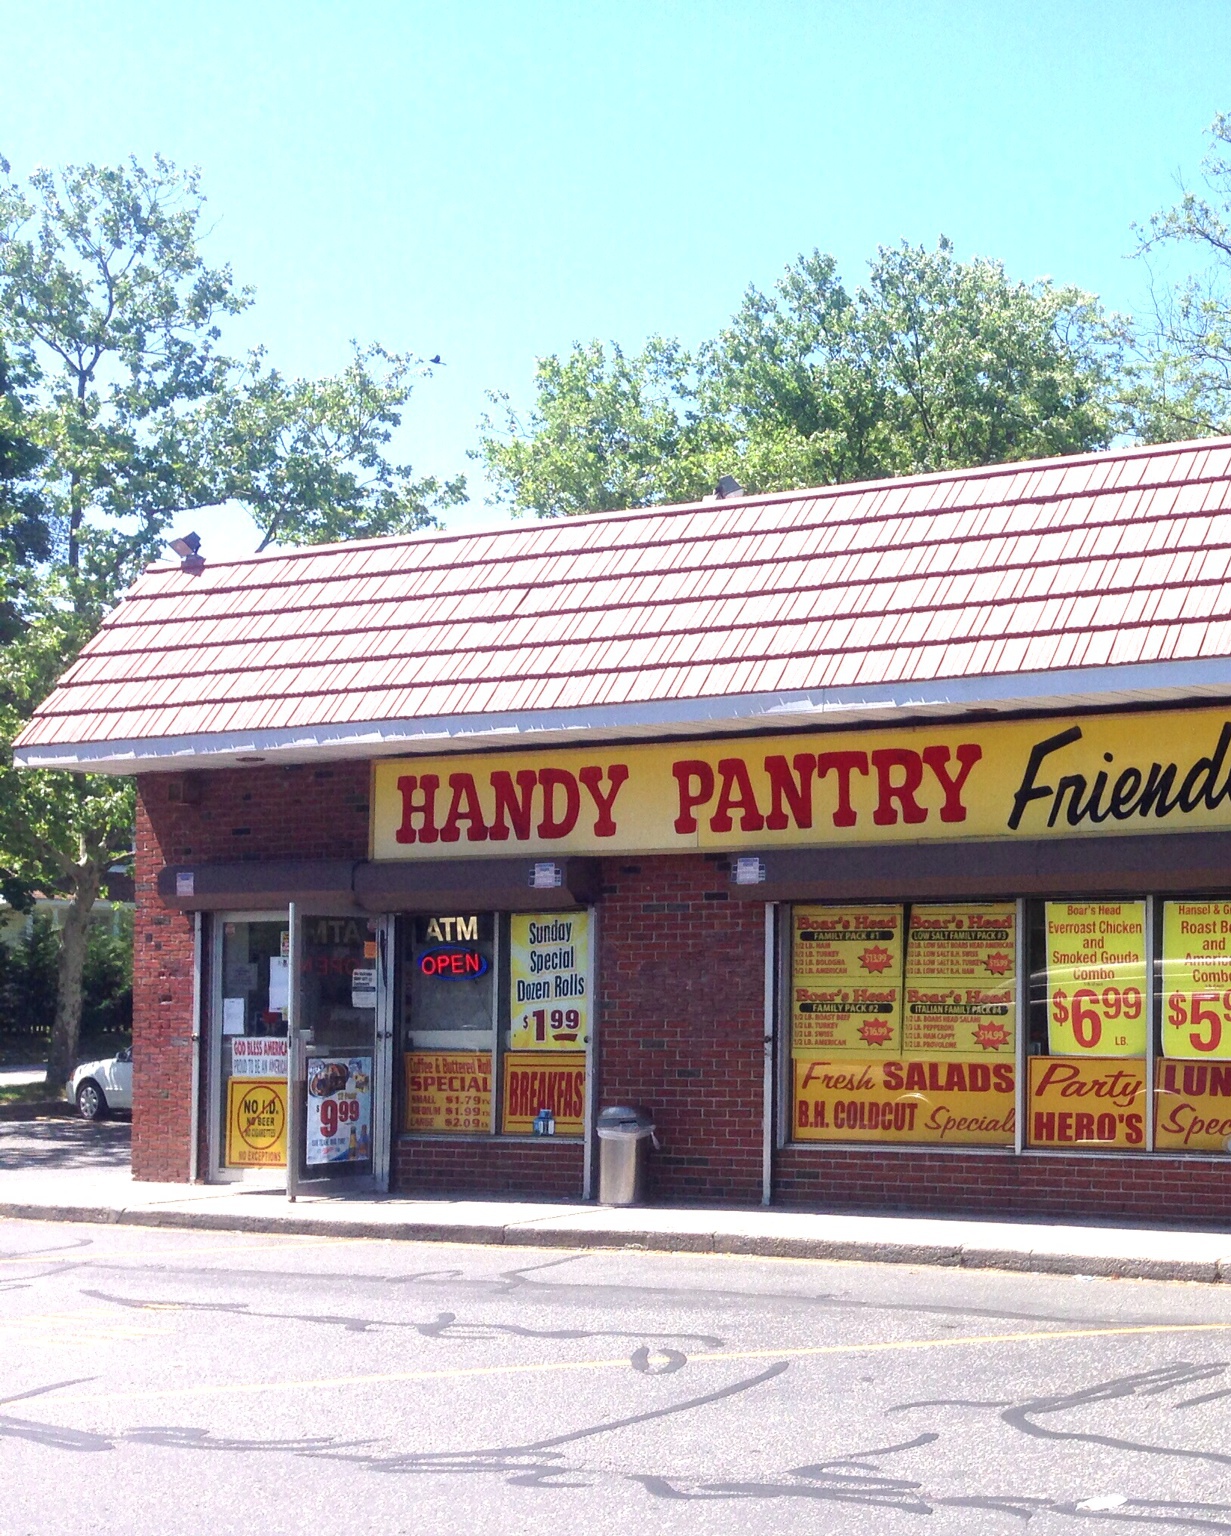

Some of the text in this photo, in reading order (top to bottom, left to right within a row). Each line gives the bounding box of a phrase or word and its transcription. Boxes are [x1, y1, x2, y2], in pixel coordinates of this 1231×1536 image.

[396, 764, 629, 844] HANDY
[672, 743, 982, 834] PANTRY
[1067, 905, 1121, 916] Boar's Head
[1179, 904, 1211, 915] Hansel
[1214, 905, 1220, 915] &
[426, 916, 478, 941] ATM
[797, 915, 897, 930] Boar's Head
[910, 914, 1012, 929] Boar's Head
[1048, 921, 1142, 934] Everroast Chicken
[1181, 921, 1217, 934] Roast
[529, 920, 572, 944] Sunday
[814, 932, 843, 940] FAMILY
[846, 932, 867, 940] PACK
[914, 932, 929, 940] LOW
[932, 932, 949, 940] SALT
[950, 932, 976, 940] FAMILY
[977, 932, 995, 940] PACK
[1082, 937, 1105, 949] and
[1203, 938, 1226, 950] and
[421, 954, 480, 975] OPEN
[530, 946, 574, 973] Special
[1052, 951, 1139, 965] Smoked Gouda
[1073, 968, 1115, 981] Combo
[517, 974, 585, 1002] Dozen Rolls
[796, 989, 896, 1003] Boar's Head
[908, 990, 1012, 1004] Boar's Head
[812, 1004, 843, 1013] FAMILY
[845, 1004, 867, 1013] PACK
[916, 1006, 943, 1014] ITALIAN
[944, 1006, 970, 1014] FAMILY
[972, 1006, 991, 1014] PACK
[234, 1040, 246, 1056] GOD
[247, 1040, 262, 1056] BLESS
[1115, 1036, 1129, 1046] LB.
[410, 1058, 433, 1073] Coffee
[442, 1058, 476, 1074] Buttered
[410, 1076, 492, 1092] SPECIAL
[802, 1062, 1015, 1093] Fresh SALADS
[1035, 1063, 1143, 1107] Party
[244, 1100, 279, 1114] NO I.D.
[412, 1095, 436, 1104] SMALL
[446, 1096, 481, 1105] $1.79
[411, 1106, 441, 1115] MEDIUM
[446, 1107, 481, 1116] $1.99
[798, 1100, 830, 1129] B.H.
[834, 1101, 918, 1131] COLDCUT
[246, 1117, 274, 1126] NO BEER
[410, 1118, 434, 1126] LARGE
[445, 1118, 480, 1127] $2.09
[1034, 1112, 1143, 1144] HERO'S
[239, 1151, 281, 1161] NO EXCEPTIONS
